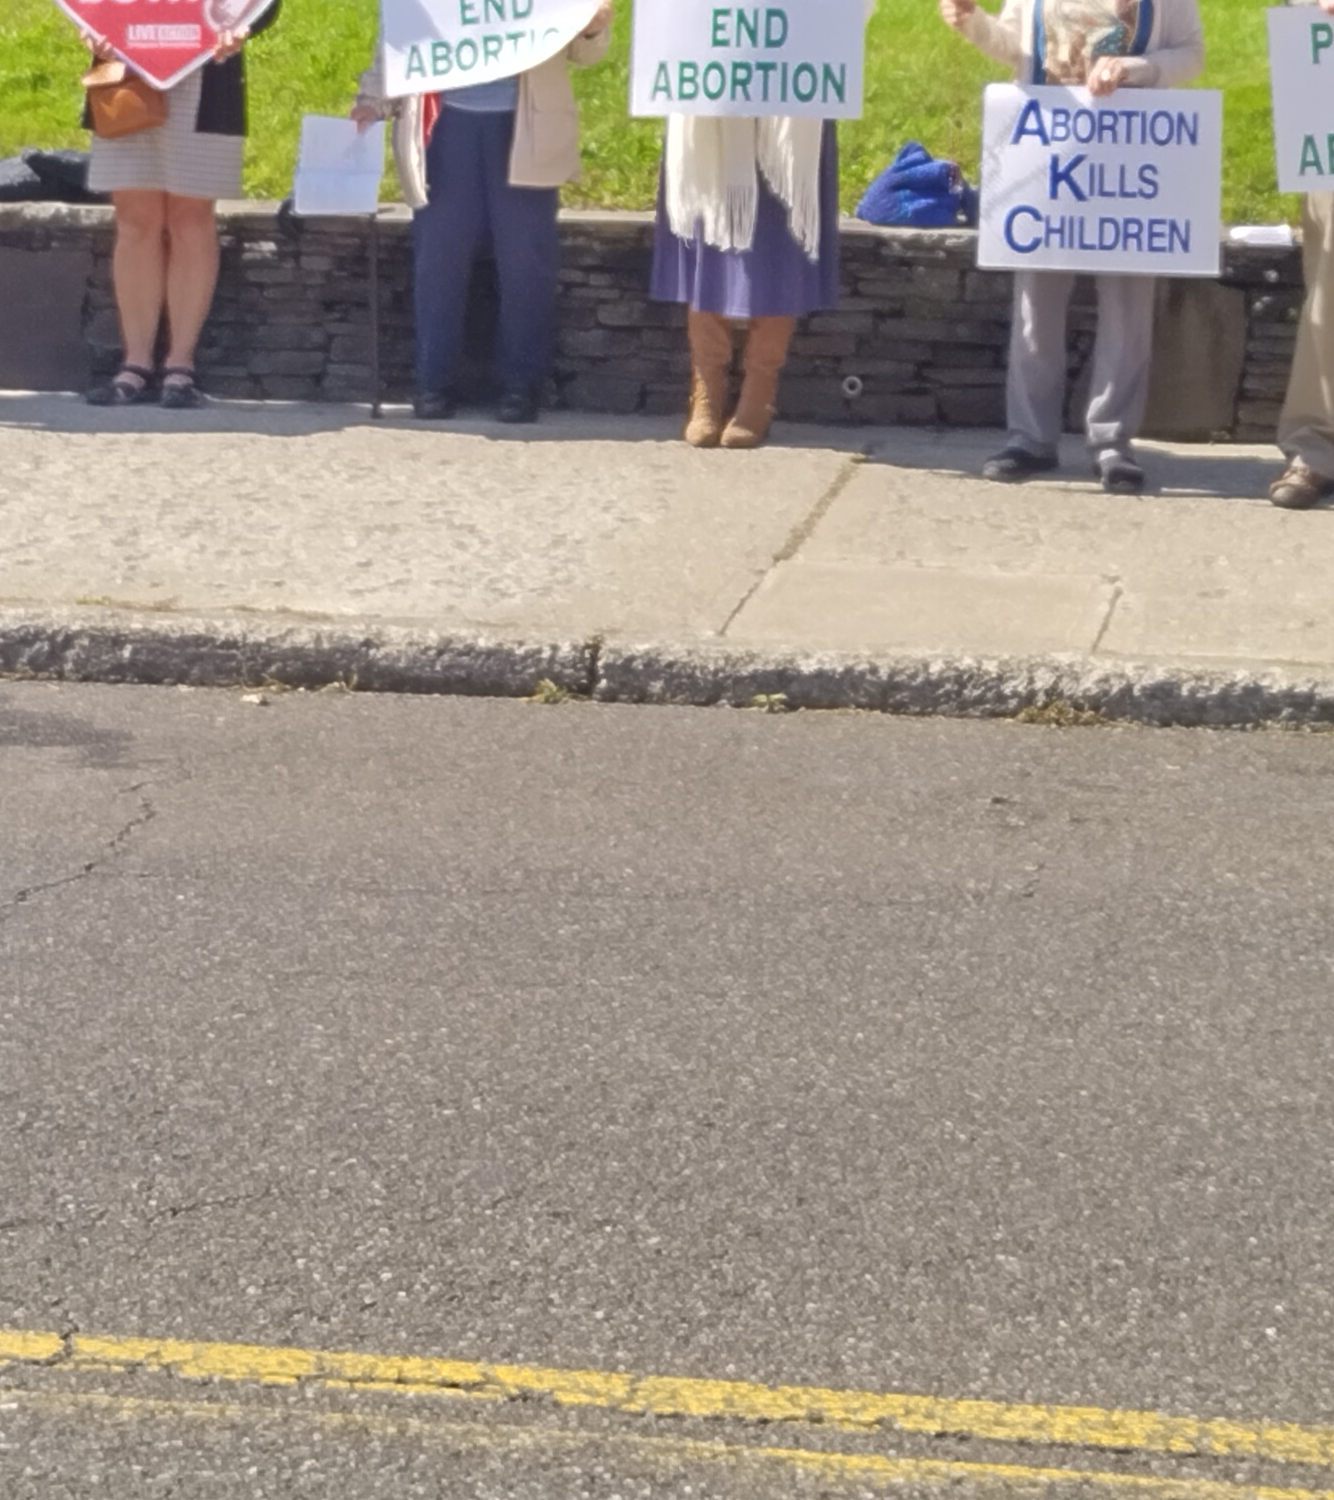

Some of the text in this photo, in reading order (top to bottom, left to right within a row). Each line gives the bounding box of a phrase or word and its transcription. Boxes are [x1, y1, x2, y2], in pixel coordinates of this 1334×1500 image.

[711, 8, 789, 48] END
[404, 27, 567, 79] ABORTI
[651, 60, 845, 103] ABORTION
[1011, 99, 1198, 146] ABORTION
[1048, 153, 1159, 201] KILLS
[1004, 205, 1191, 253] CHILDREN
